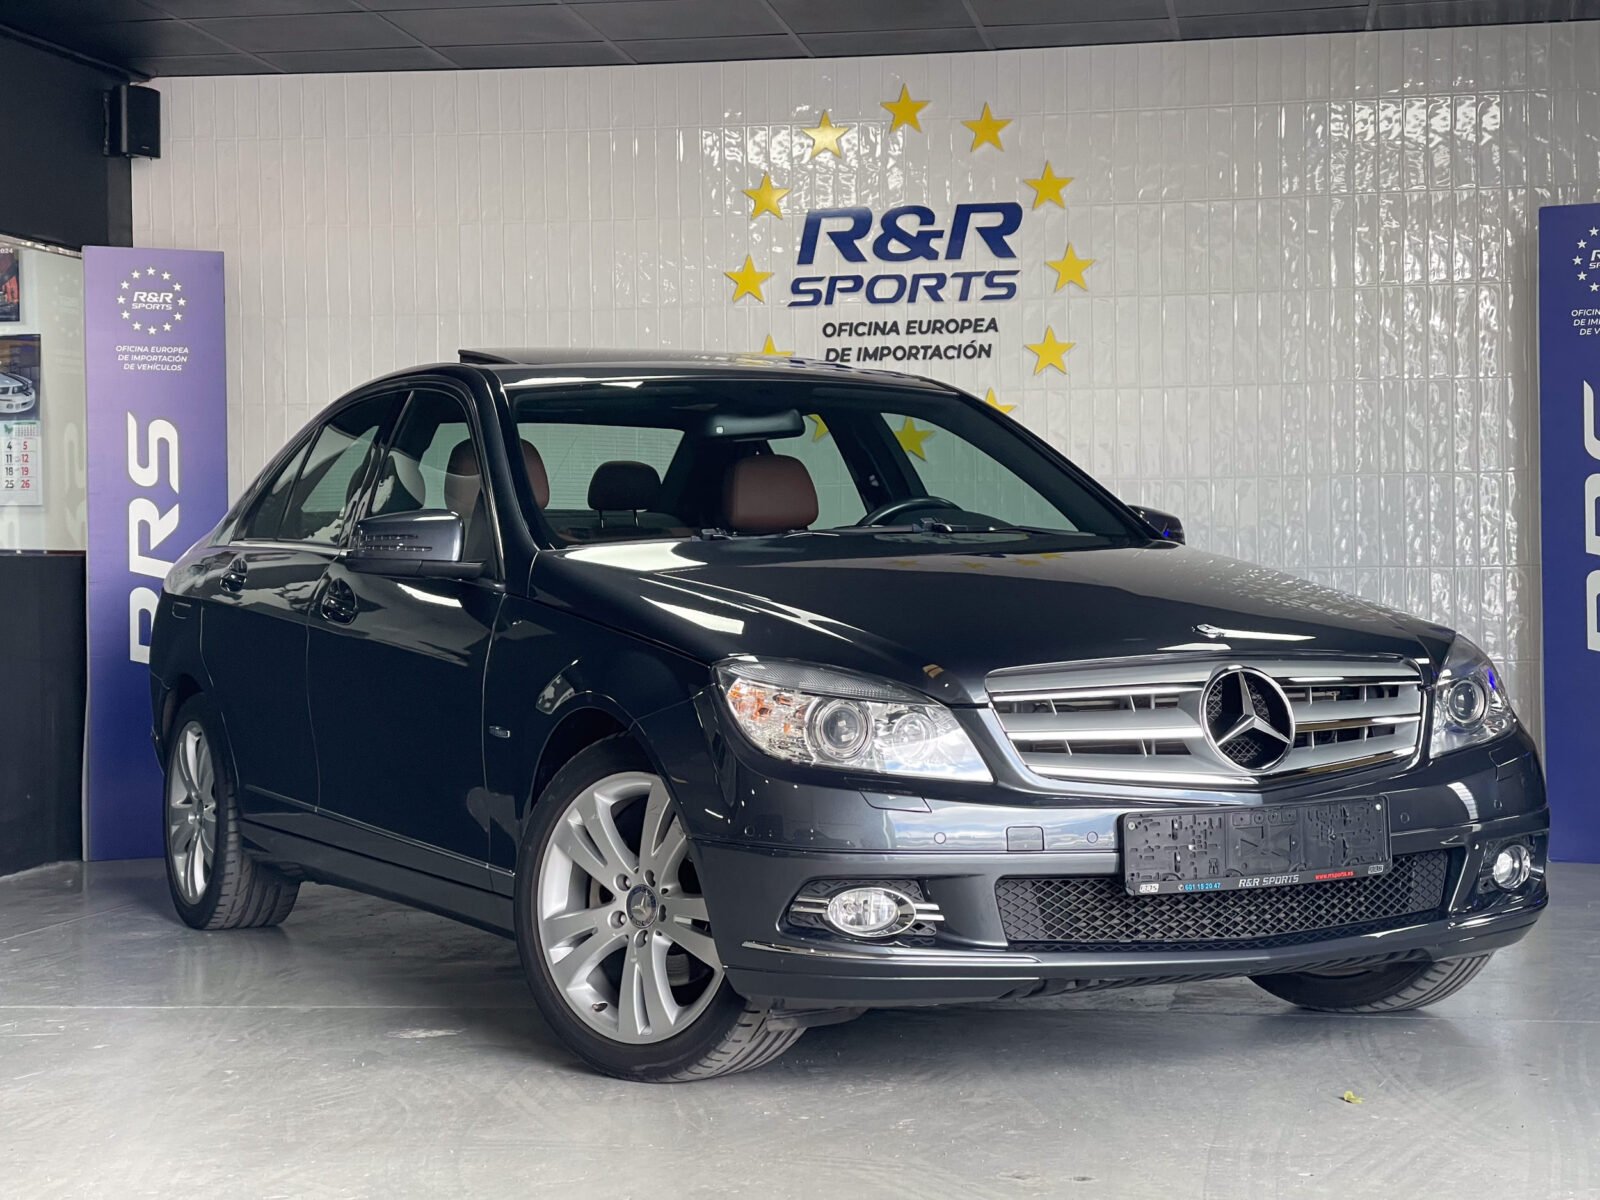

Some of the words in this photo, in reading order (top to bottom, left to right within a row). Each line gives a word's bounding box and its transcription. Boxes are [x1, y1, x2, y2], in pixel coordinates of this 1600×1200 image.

[797, 202, 1023, 265] R&R
[787, 270, 1021, 307] SPORTS
[133, 291, 173, 303] R&R
[822, 320, 900, 338] OFICINA
[905, 317, 999, 336] EUROPEA
[825, 347, 852, 362] DE
[856, 340, 992, 362] IMPORTACIÓN
[131, 354, 187, 362] IMPORTACIÓN
[137, 362, 182, 371] VEHÍCULOS
[7, 441, 13, 451] 4
[23, 441, 28, 450] 5
[6, 454, 12, 463] 11
[21, 454, 29, 463] 12
[5, 467, 13, 475] 18
[21, 467, 29, 475] 19
[5, 480, 14, 488] 25
[21, 480, 30, 488] 26
[1239, 878, 1260, 887] R&R
[1262, 875, 1299, 885] SPORTS
